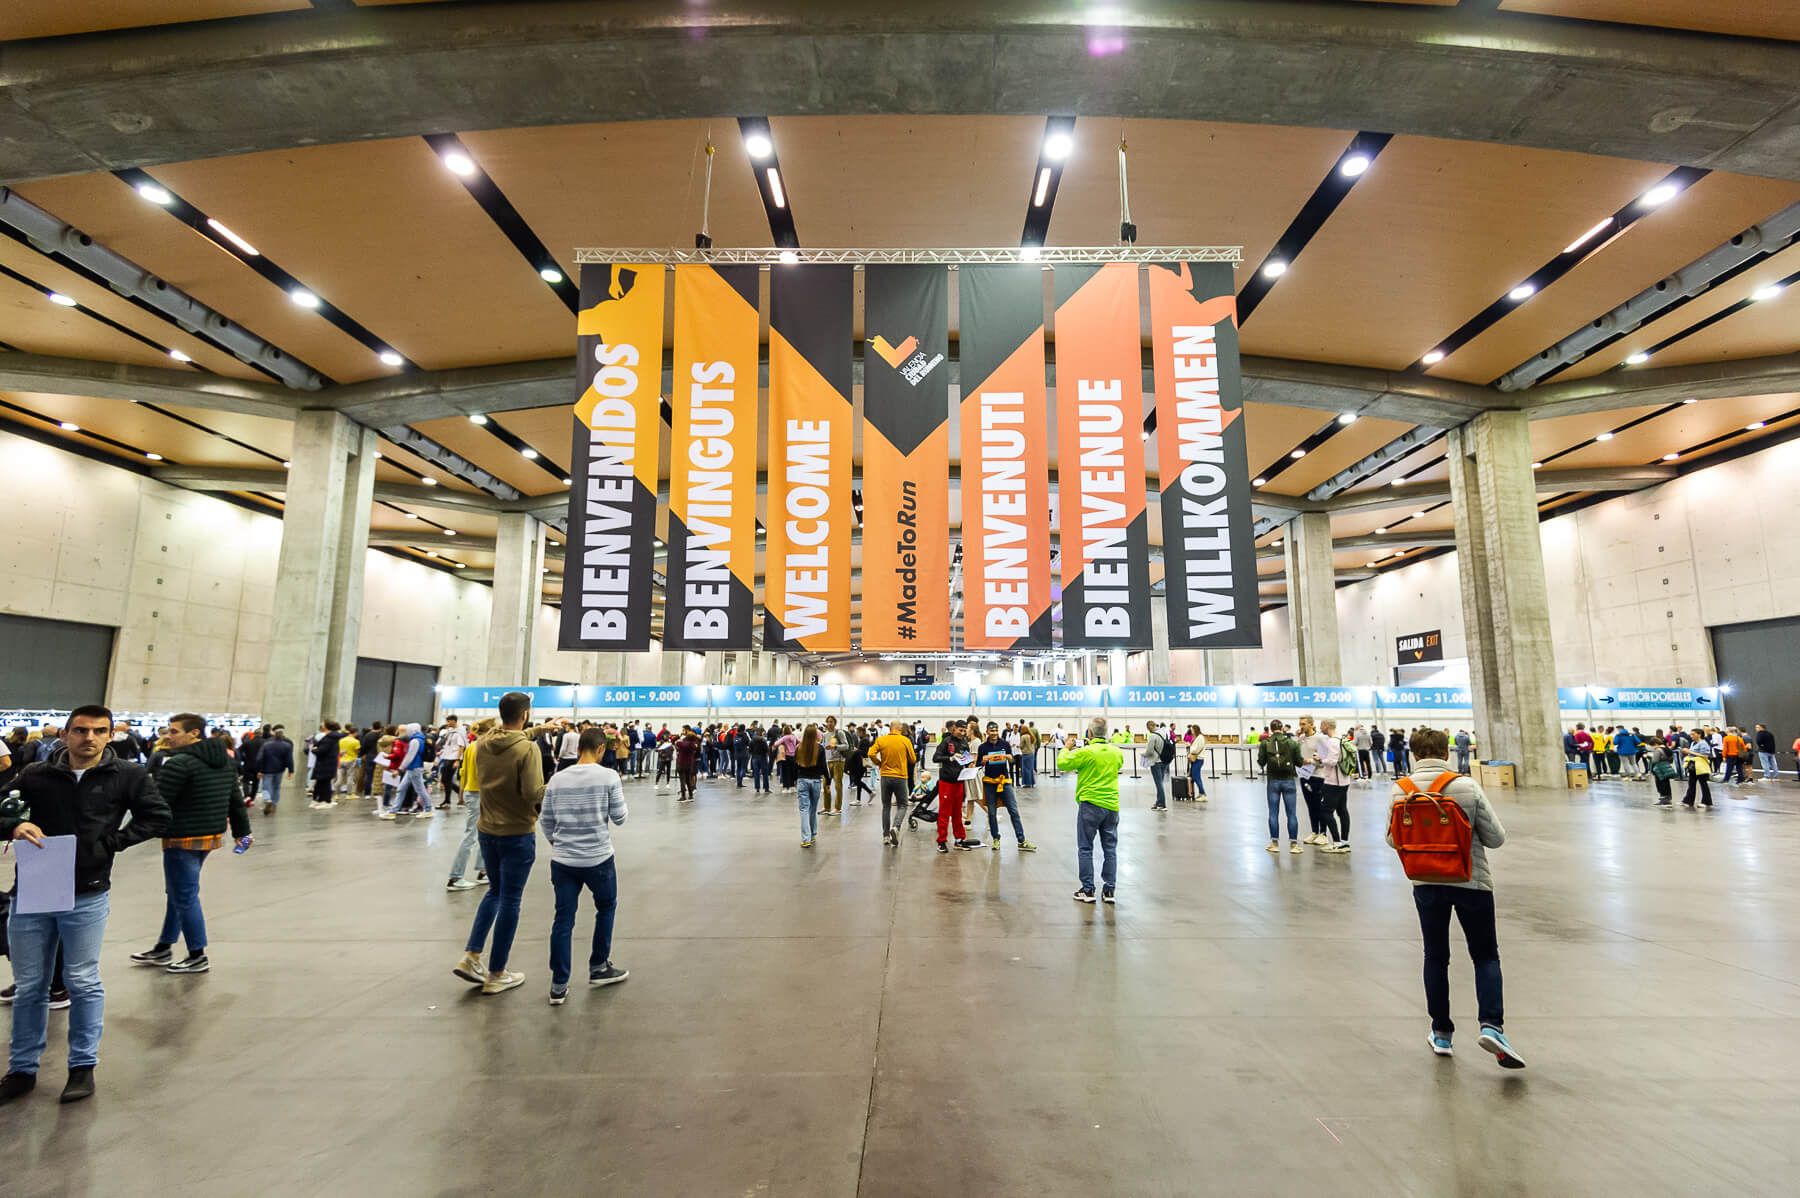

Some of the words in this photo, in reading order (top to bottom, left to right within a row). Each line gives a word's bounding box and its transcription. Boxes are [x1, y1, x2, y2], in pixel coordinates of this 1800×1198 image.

[1172, 325, 1237, 640] WILLKOMMEN
[580, 343, 639, 641] BIENVENIDOS
[683, 361, 735, 640] BENVINGUTS
[980, 392, 1030, 638] BENVENUTI
[1078, 379, 1131, 638] BIENVENUE
[783, 419, 830, 641] WELCOME
[896, 480, 917, 640] #MadeToRun
[1399, 637, 1424, 651] SALIDA
[1426, 634, 1438, 647] EXIT
[483, 692, 489, 703] 1
[605, 691, 636, 702] 5.001
[649, 691, 681, 702] 9.000
[735, 691, 765, 701] 9.001
[780, 691, 817, 701] 13.000
[865, 690, 900, 701] 13.001
[914, 690, 952, 701] 17.000
[997, 690, 1032, 701] 17.001
[1046, 690, 1083, 701] 21.000
[1128, 691, 1165, 702] 21.001
[1179, 691, 1217, 702] 25.000
[1262, 692, 1299, 703] 25.001
[1312, 692, 1352, 703] 29.000
